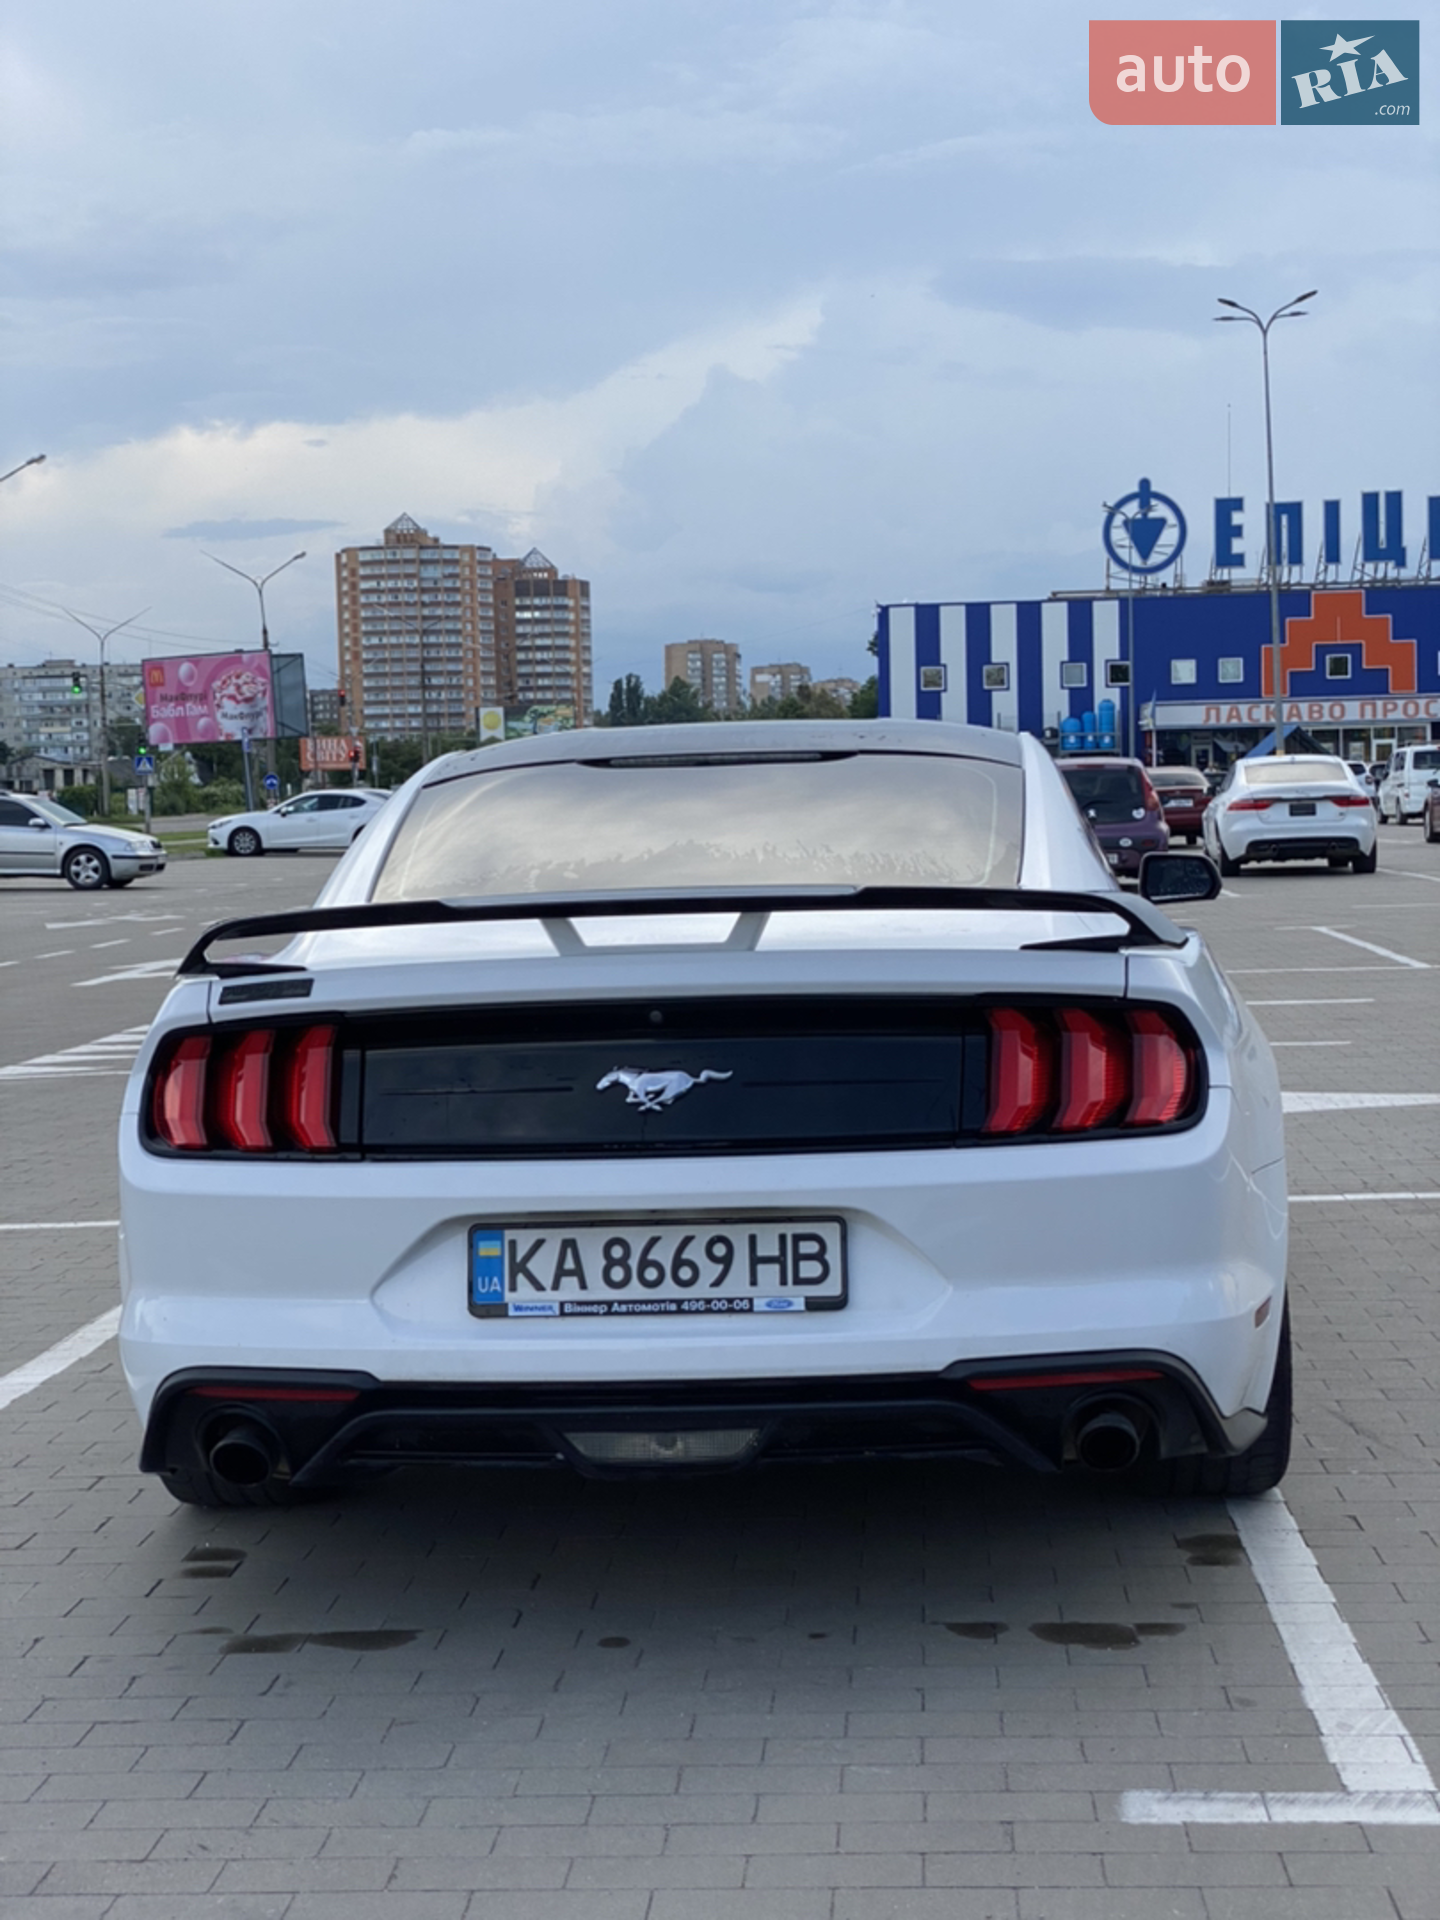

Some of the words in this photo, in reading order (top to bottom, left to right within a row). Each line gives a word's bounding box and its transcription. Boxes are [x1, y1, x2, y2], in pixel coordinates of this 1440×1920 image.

[151, 703, 184, 718] Бабл
[1203, 701, 1346, 725] ЛАСКАВО
[1359, 699, 1439, 720] ПРОС
[508, 1238, 588, 1292] KA
[602, 1234, 735, 1289] 8669
[748, 1233, 831, 1287] HB
[478, 1277, 501, 1293] UA
[564, 1302, 608, 1314] Віннер
[611, 1301, 677, 1313] Автомотів
[681, 1299, 750, 1311] 496-00-06
